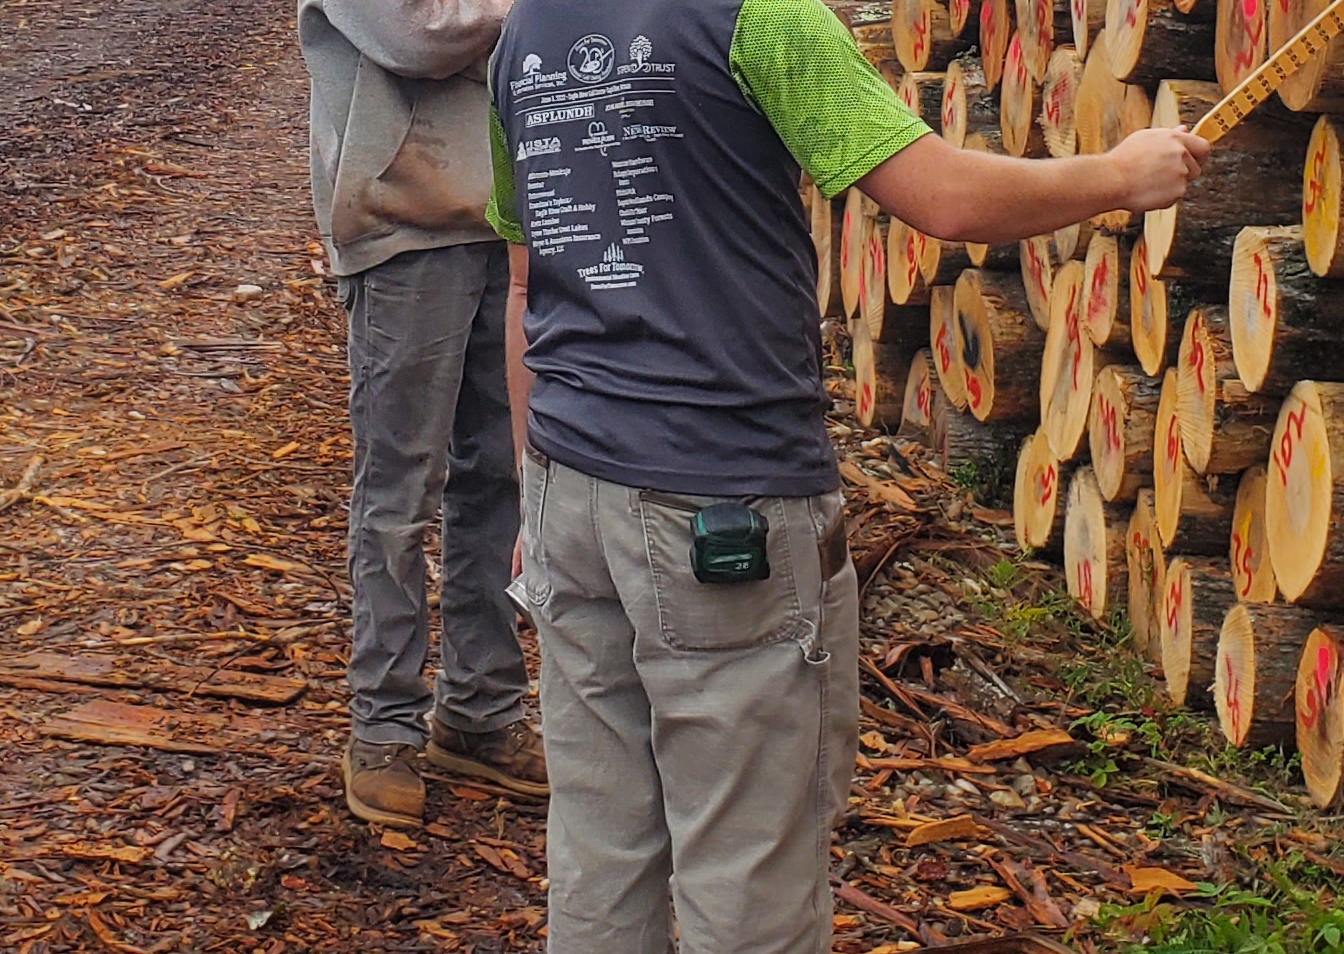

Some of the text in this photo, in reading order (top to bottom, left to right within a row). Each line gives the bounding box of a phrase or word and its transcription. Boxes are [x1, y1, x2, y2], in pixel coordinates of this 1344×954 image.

[526, 104, 594, 127] ASPLUNDH
[576, 264, 599, 279] Trees
[598, 261, 612, 274] For
